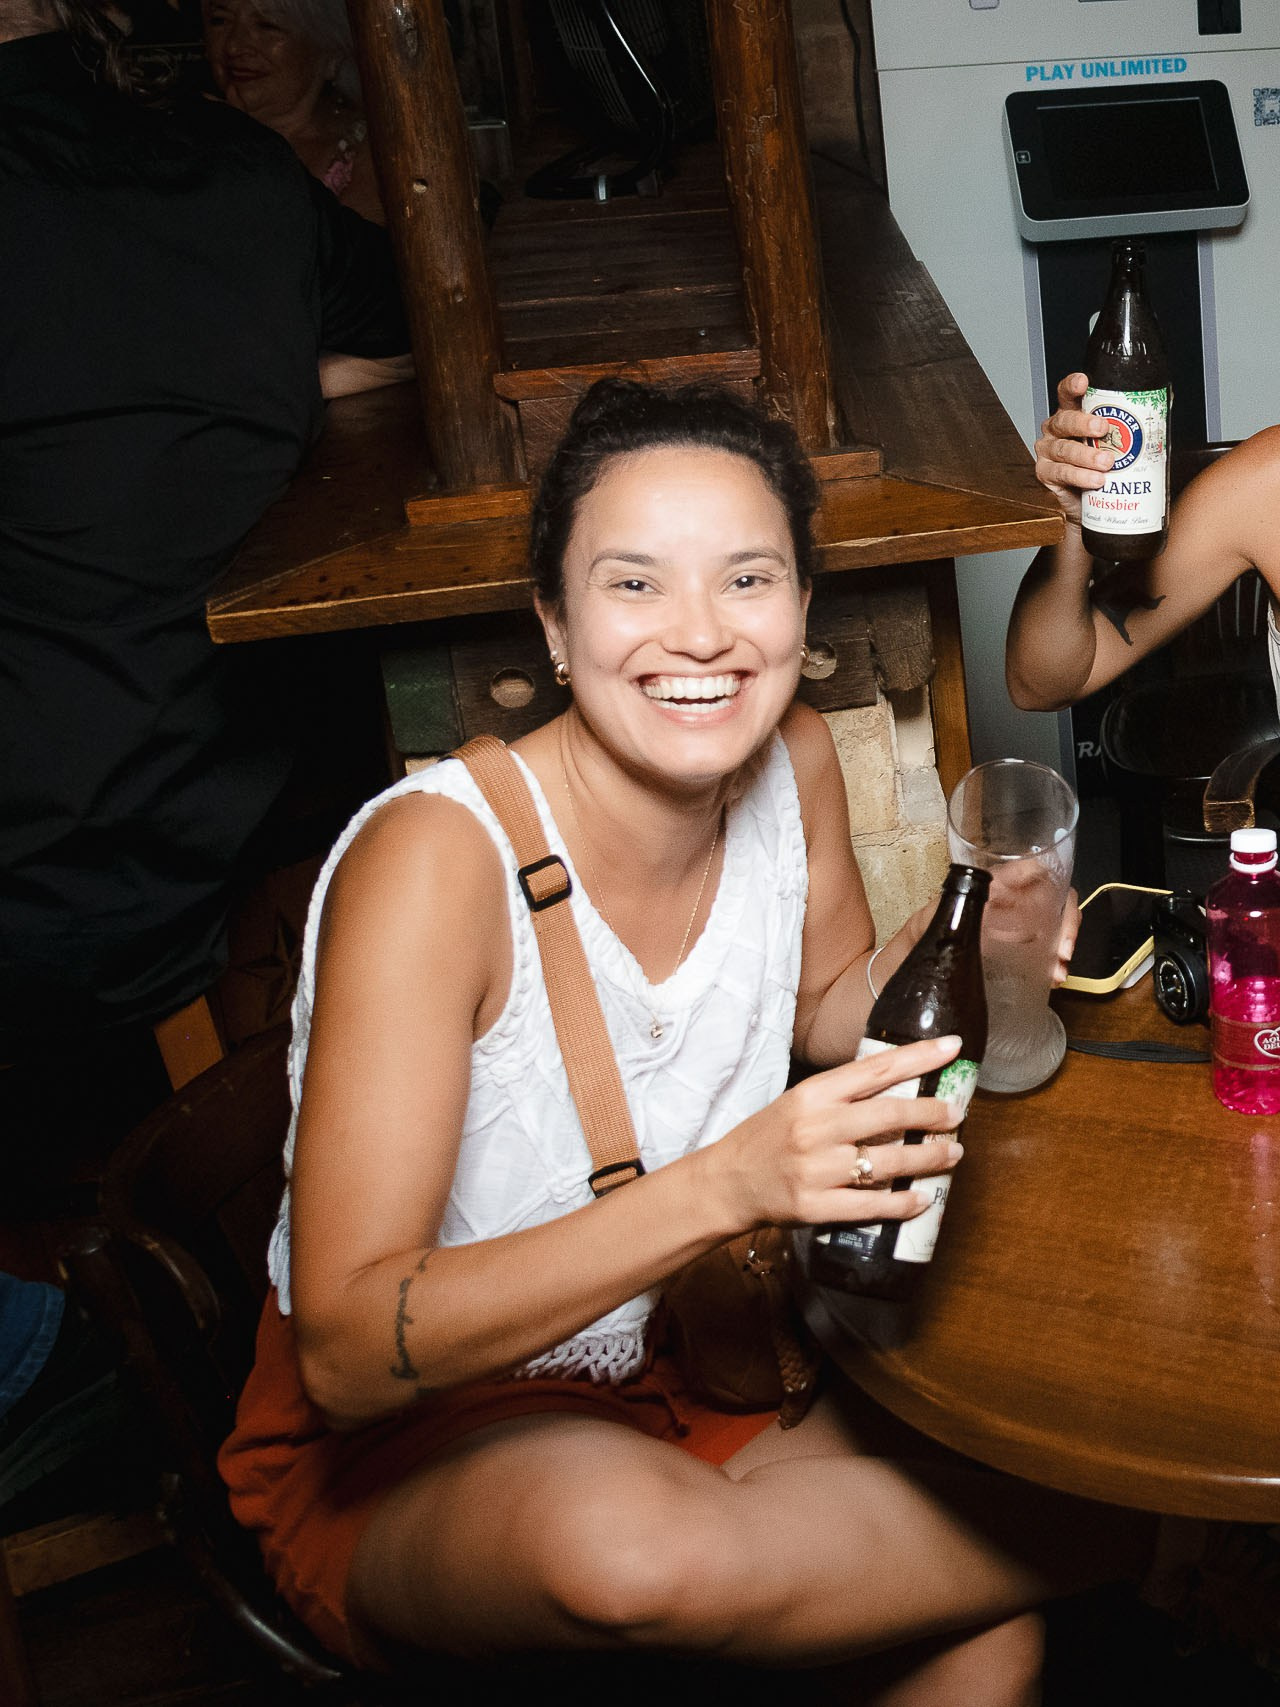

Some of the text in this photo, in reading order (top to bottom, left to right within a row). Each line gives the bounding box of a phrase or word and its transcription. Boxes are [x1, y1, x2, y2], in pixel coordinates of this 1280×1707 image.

[1026, 58, 1187, 82] PLAY UNLIMITED
[1095, 407, 1139, 432] ULANER
[1102, 480, 1152, 495] LANER
[1088, 495, 1140, 511] Weissbier
